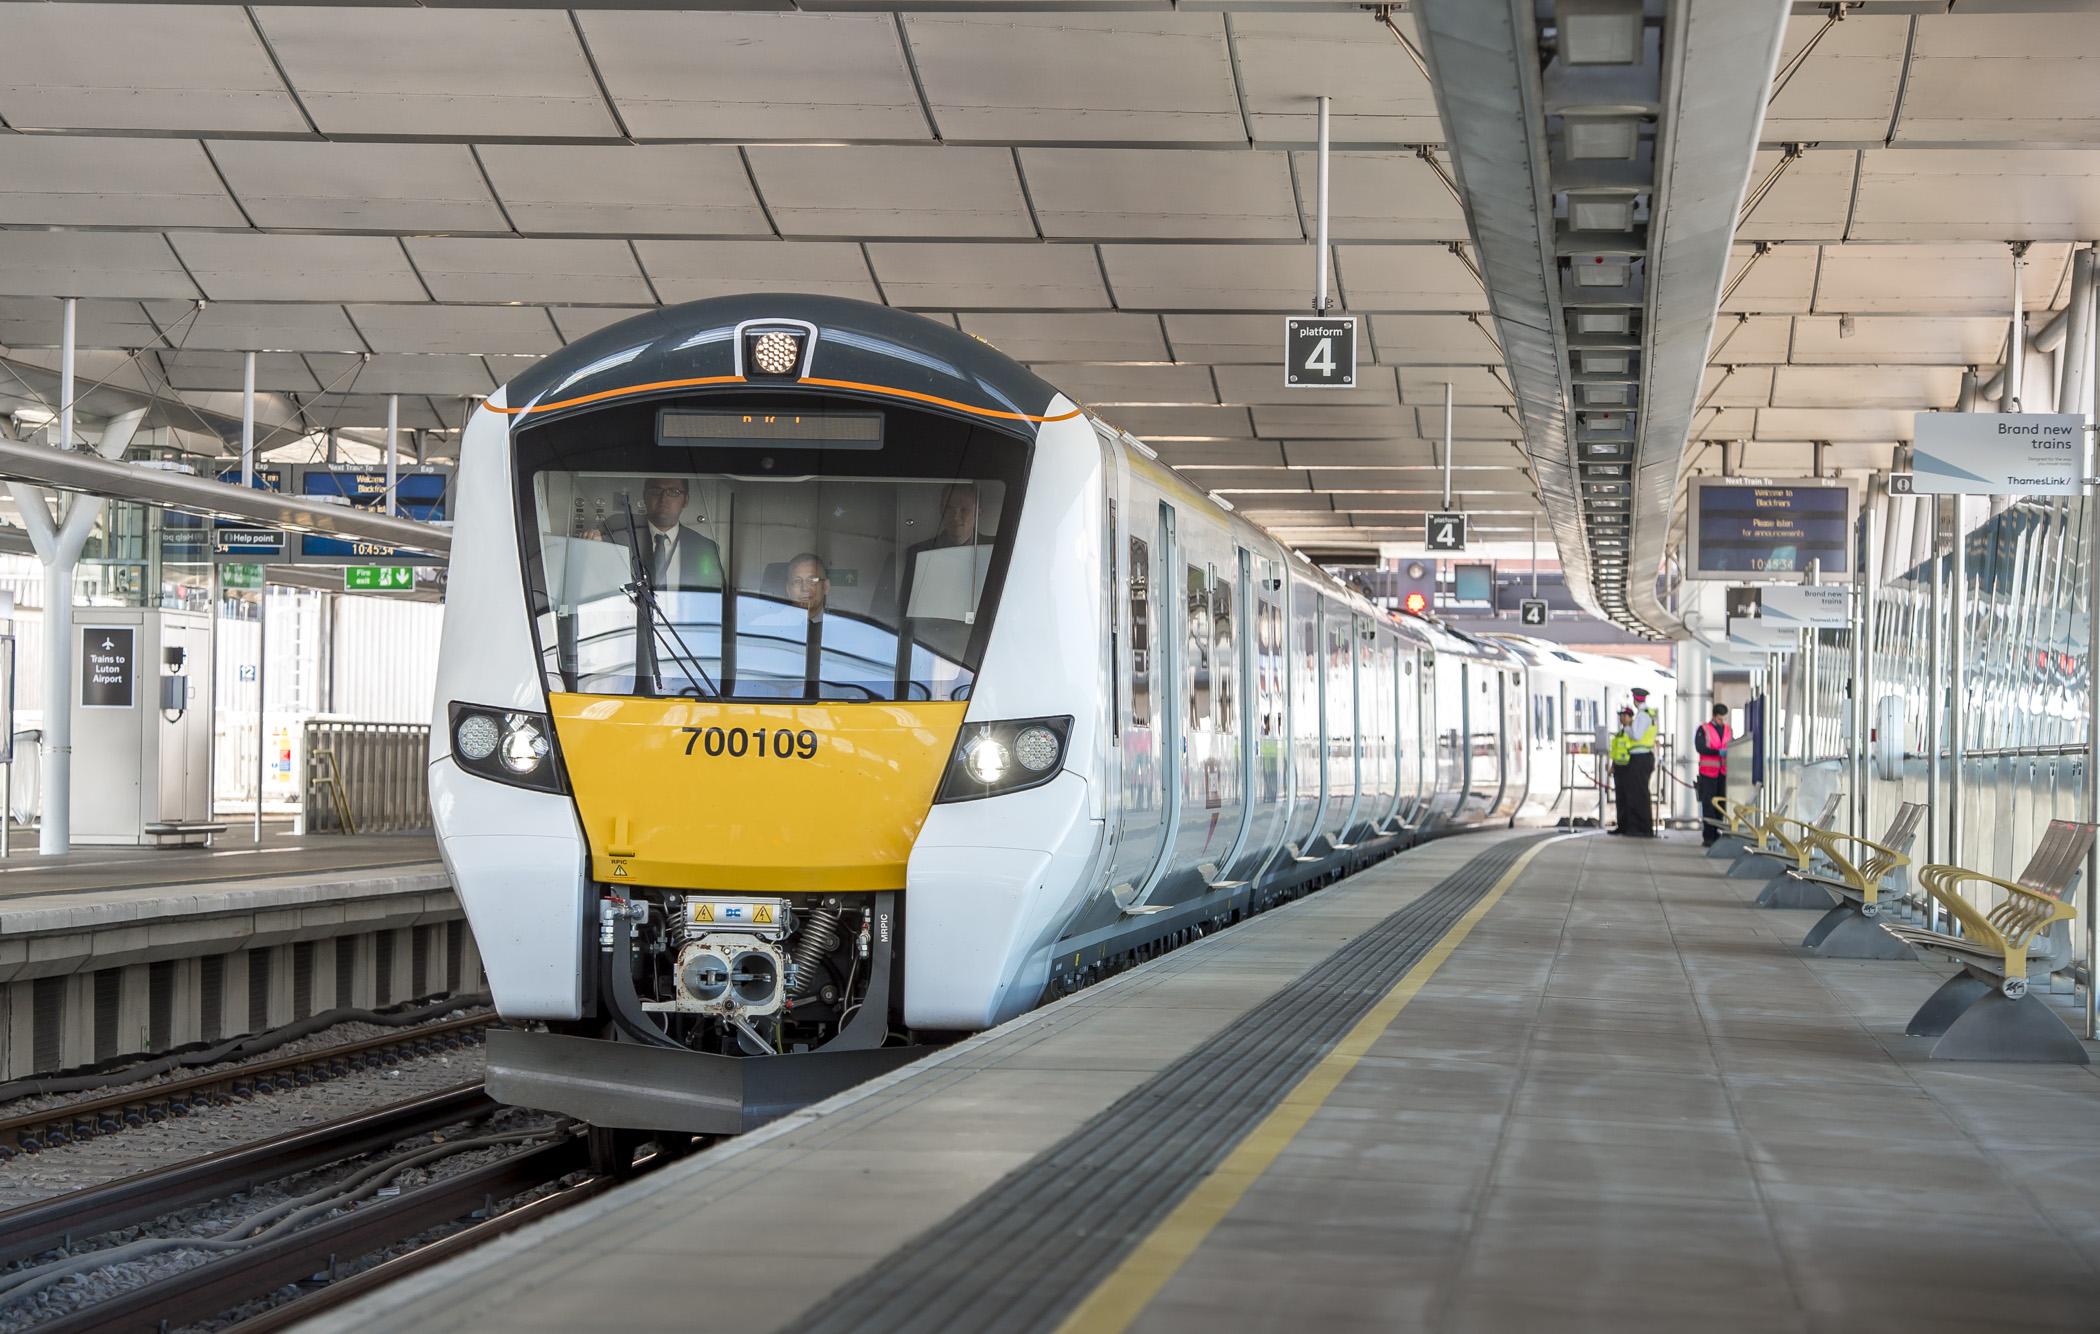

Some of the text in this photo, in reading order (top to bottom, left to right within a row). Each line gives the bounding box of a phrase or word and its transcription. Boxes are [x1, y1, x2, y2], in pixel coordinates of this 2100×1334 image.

[1300, 327, 1343, 338] platform
[1304, 337, 1337, 377] 4
[1998, 423, 2072, 435] Brand new
[2031, 438, 2072, 449] trains
[254, 462, 268, 471] Exp
[420, 465, 434, 473] Exp
[1821, 479, 1836, 487] Exp
[233, 533, 274, 543] Help point
[1436, 523, 1456, 547] 4
[356, 568, 371, 576] Fire
[1526, 607, 1540, 623] 4
[90, 654, 126, 663] Trains to
[95, 664, 120, 673] Luton
[92, 674, 123, 684] Airport
[681, 726, 818, 760] 700109
[880, 913, 889, 943] MRPIC
